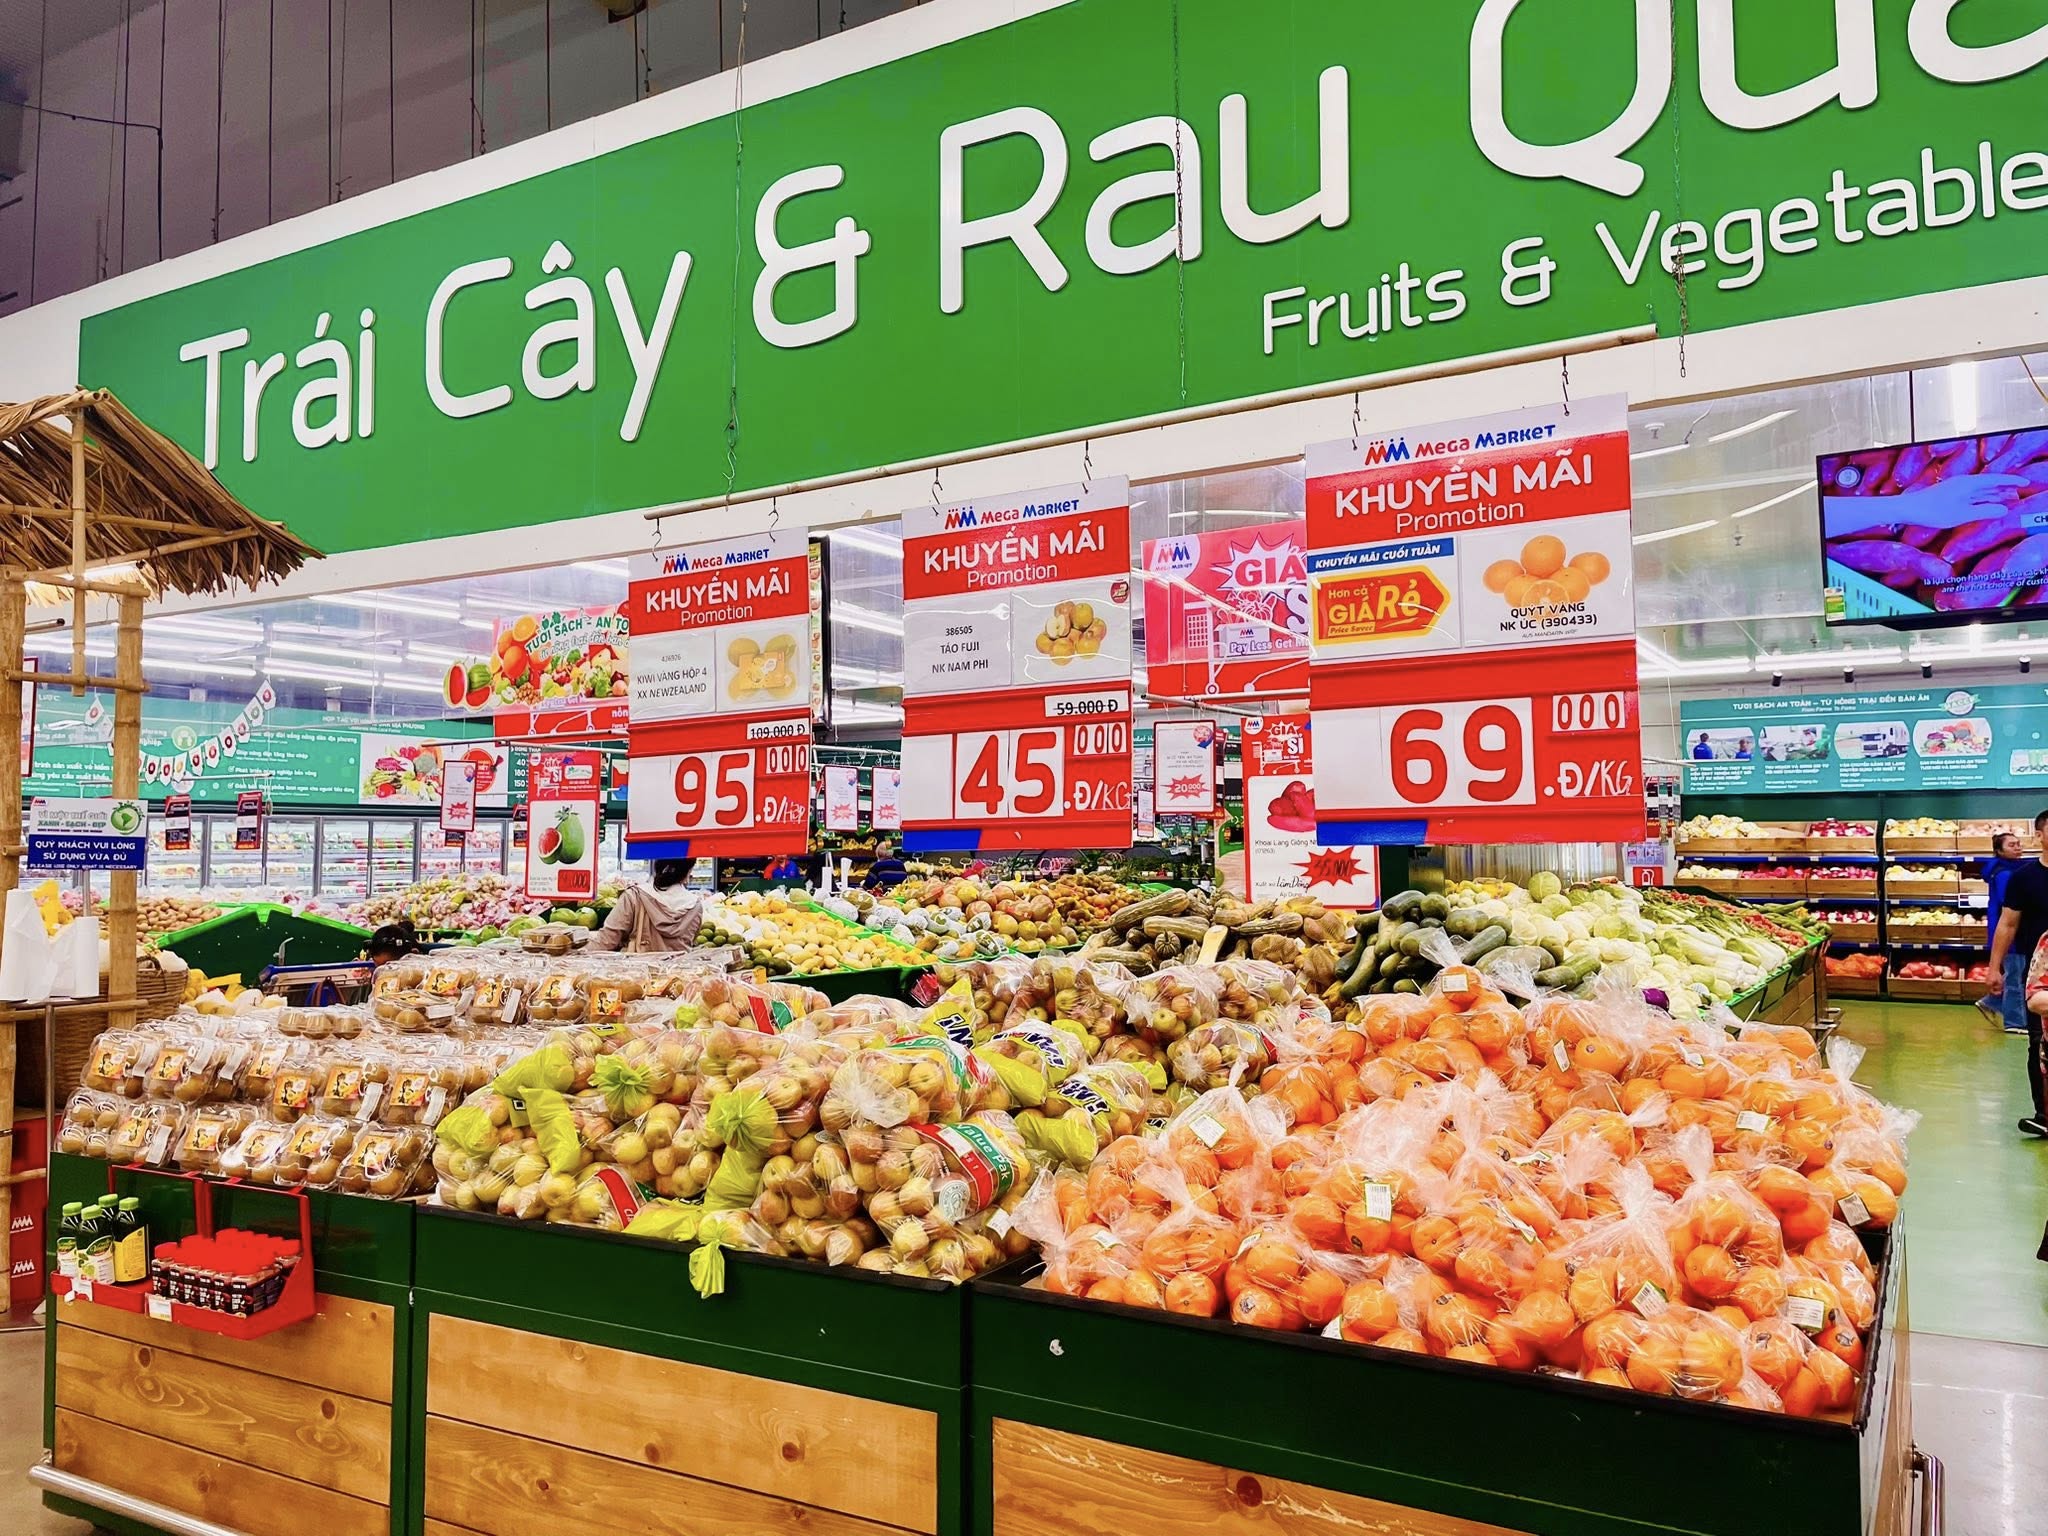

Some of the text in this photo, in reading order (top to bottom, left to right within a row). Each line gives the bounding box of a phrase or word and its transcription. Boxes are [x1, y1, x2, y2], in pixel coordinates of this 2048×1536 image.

[179, 307, 376, 470] Trái
[425, 240, 692, 441] Cây
[752, 165, 871, 348] &
[940, 65, 1350, 314] Rau
[1263, 262, 1467, 354] Fruits
[1501, 237, 1556, 306] &
[1335, 448, 1592, 518] KHUYẾN MÃI
[1396, 501, 1524, 534] Promotion
[924, 520, 1105, 574] KHUYẾN MÃI
[1315, 542, 1441, 569] KHUYẾN MÃI CUỐI TUẦN
[967, 563, 1058, 588] Promotion
[646, 567, 790, 613] KHUYẾN MÃI
[1328, 585, 1368, 599] Hơn cả
[1328, 578, 1421, 624] GIÁ Rẻ
[1511, 602, 1585, 619] QUÝT VÀNG
[681, 605, 753, 626] Promotion
[1500, 614, 1597, 631] NK ÚC (390433)
[554, 618, 583, 637] SẠCH
[596, 617, 612, 628] AN
[945, 626, 973, 637] 386505
[940, 641, 980, 655] TÁO FUJI
[1229, 638, 1293, 655] Pay Less Get
[637, 667, 707, 684] KIWI VÀNG HỘP 4
[932, 660, 989, 674] NK NAM PHI
[637, 683, 707, 699] XX NEWZEALAND
[1056, 699, 1103, 715] 59.000
[1390, 693, 1620, 804] 69 000
[960, 723, 1123, 815] 45 000
[675, 746, 807, 827] 95 000
[1174, 783, 1188, 793] 20
[57, 840, 91, 849] KHÁCH
[111, 841, 136, 850] LÒNG
[1255, 839, 1271, 847] Khoai
[1273, 839, 1289, 848] Lang
[60, 852, 86, 862] DỤNG
[957, 1125, 1011, 1180] Value Pak
